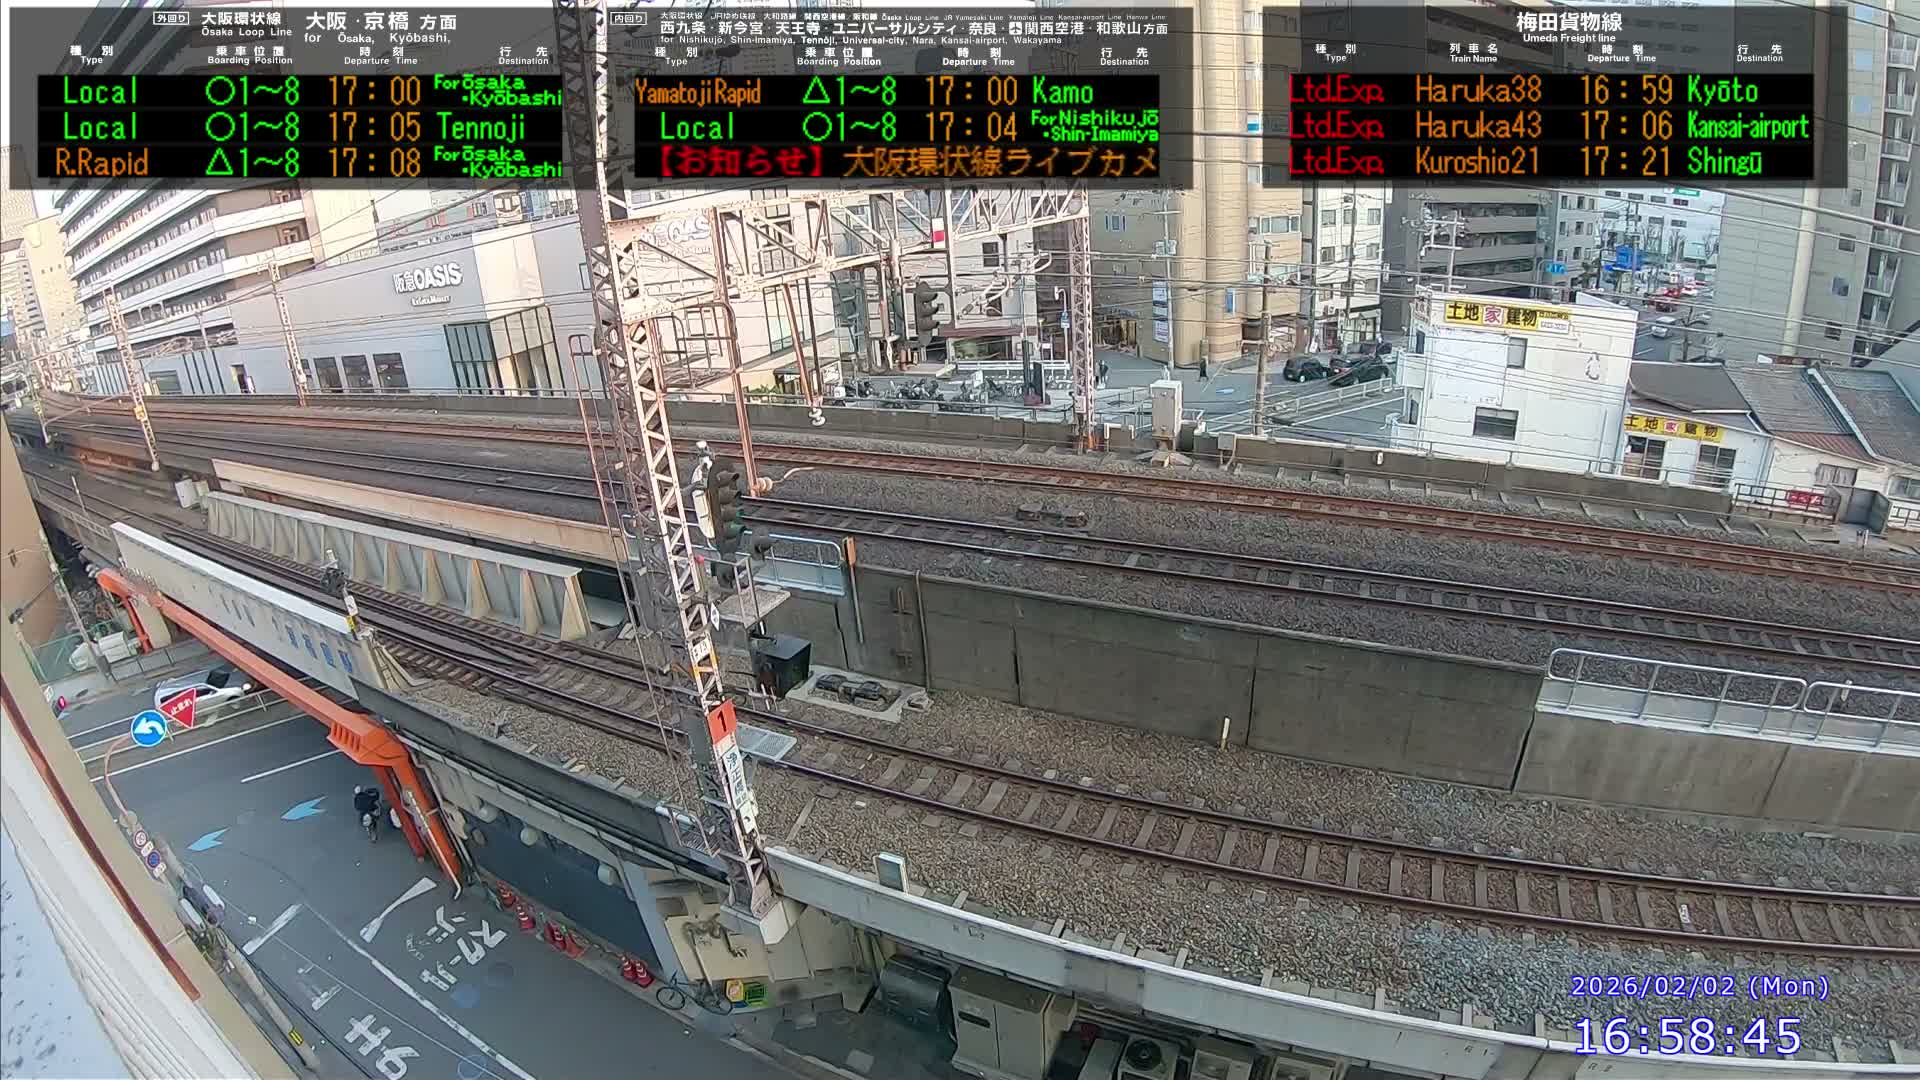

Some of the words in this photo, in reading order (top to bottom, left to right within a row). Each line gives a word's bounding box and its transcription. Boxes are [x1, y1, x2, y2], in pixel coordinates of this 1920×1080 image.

[414, 262, 463, 290] OASIS
[171, 698, 193, 716] 止まれ
[716, 710, 727, 732] 1
[420, 919, 507, 991] スクール
